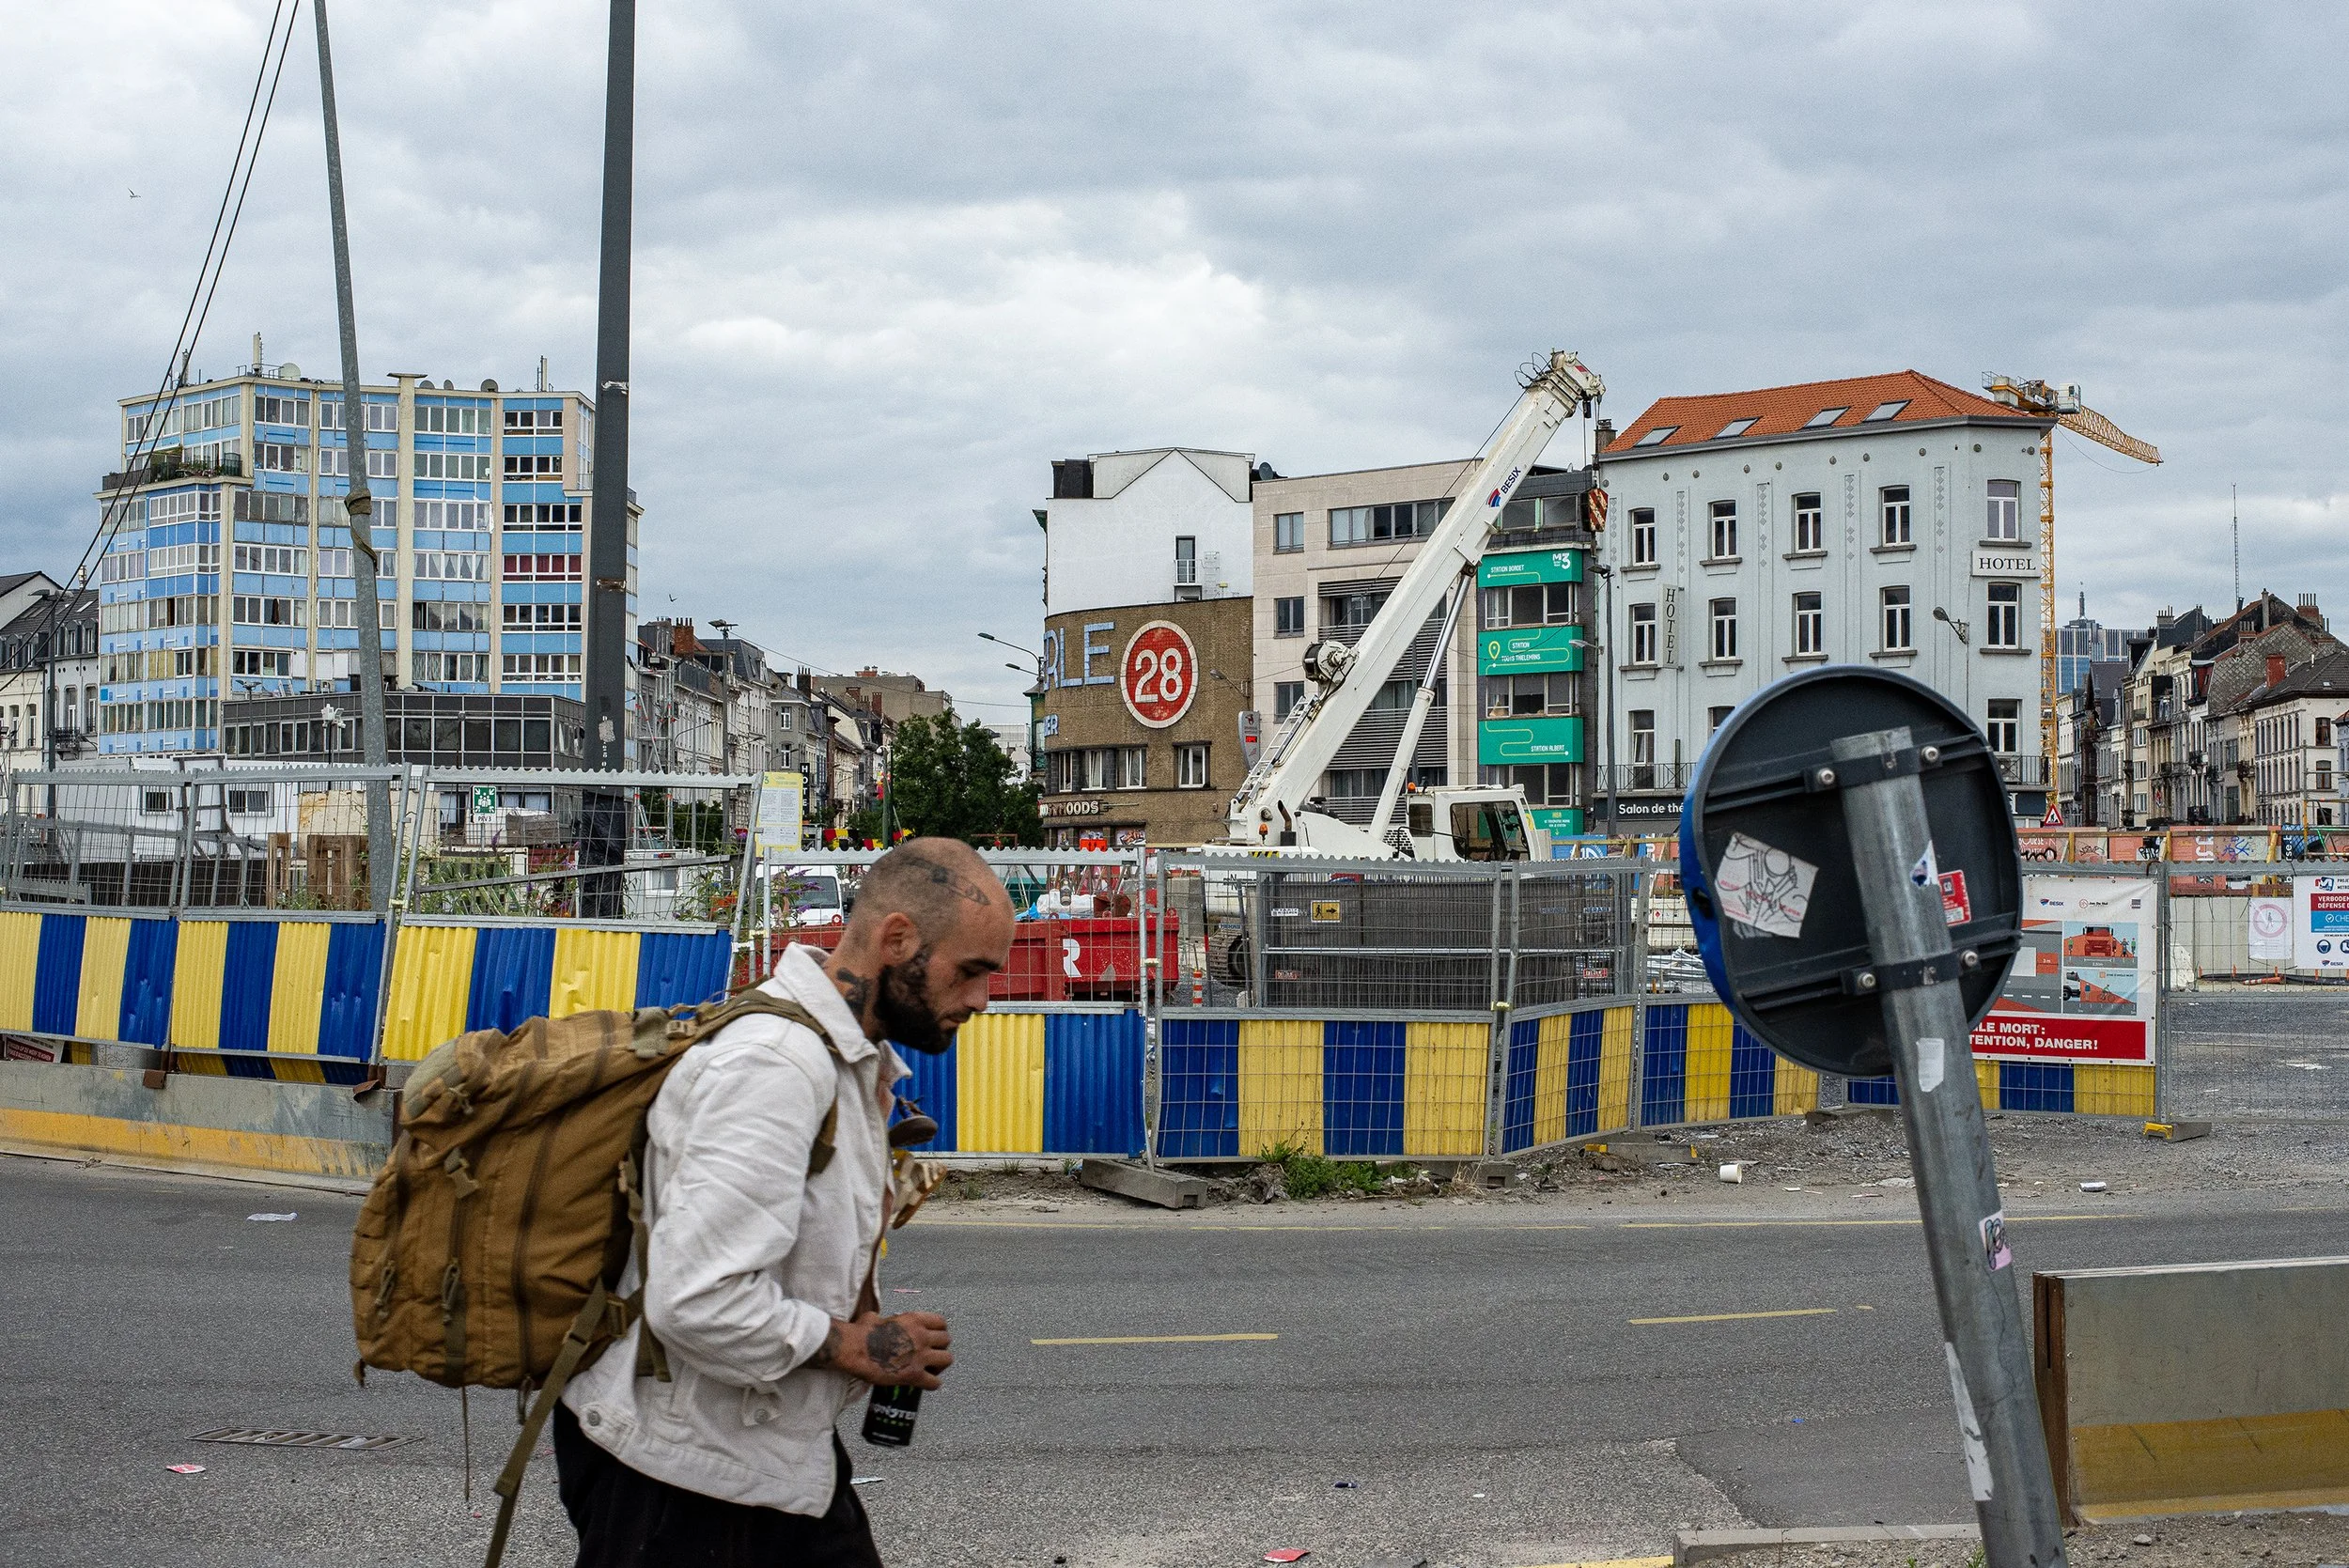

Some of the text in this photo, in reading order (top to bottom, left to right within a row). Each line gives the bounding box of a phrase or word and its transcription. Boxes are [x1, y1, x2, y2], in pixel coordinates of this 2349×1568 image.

[1501, 466, 1521, 494] BESIX
[1979, 557, 2036, 570] HOTEL
[1665, 588, 1676, 664] HOTEL
[1135, 647, 1183, 703] 28
[1618, 803, 1649, 815] Salon
[1651, 804, 1665, 814] de
